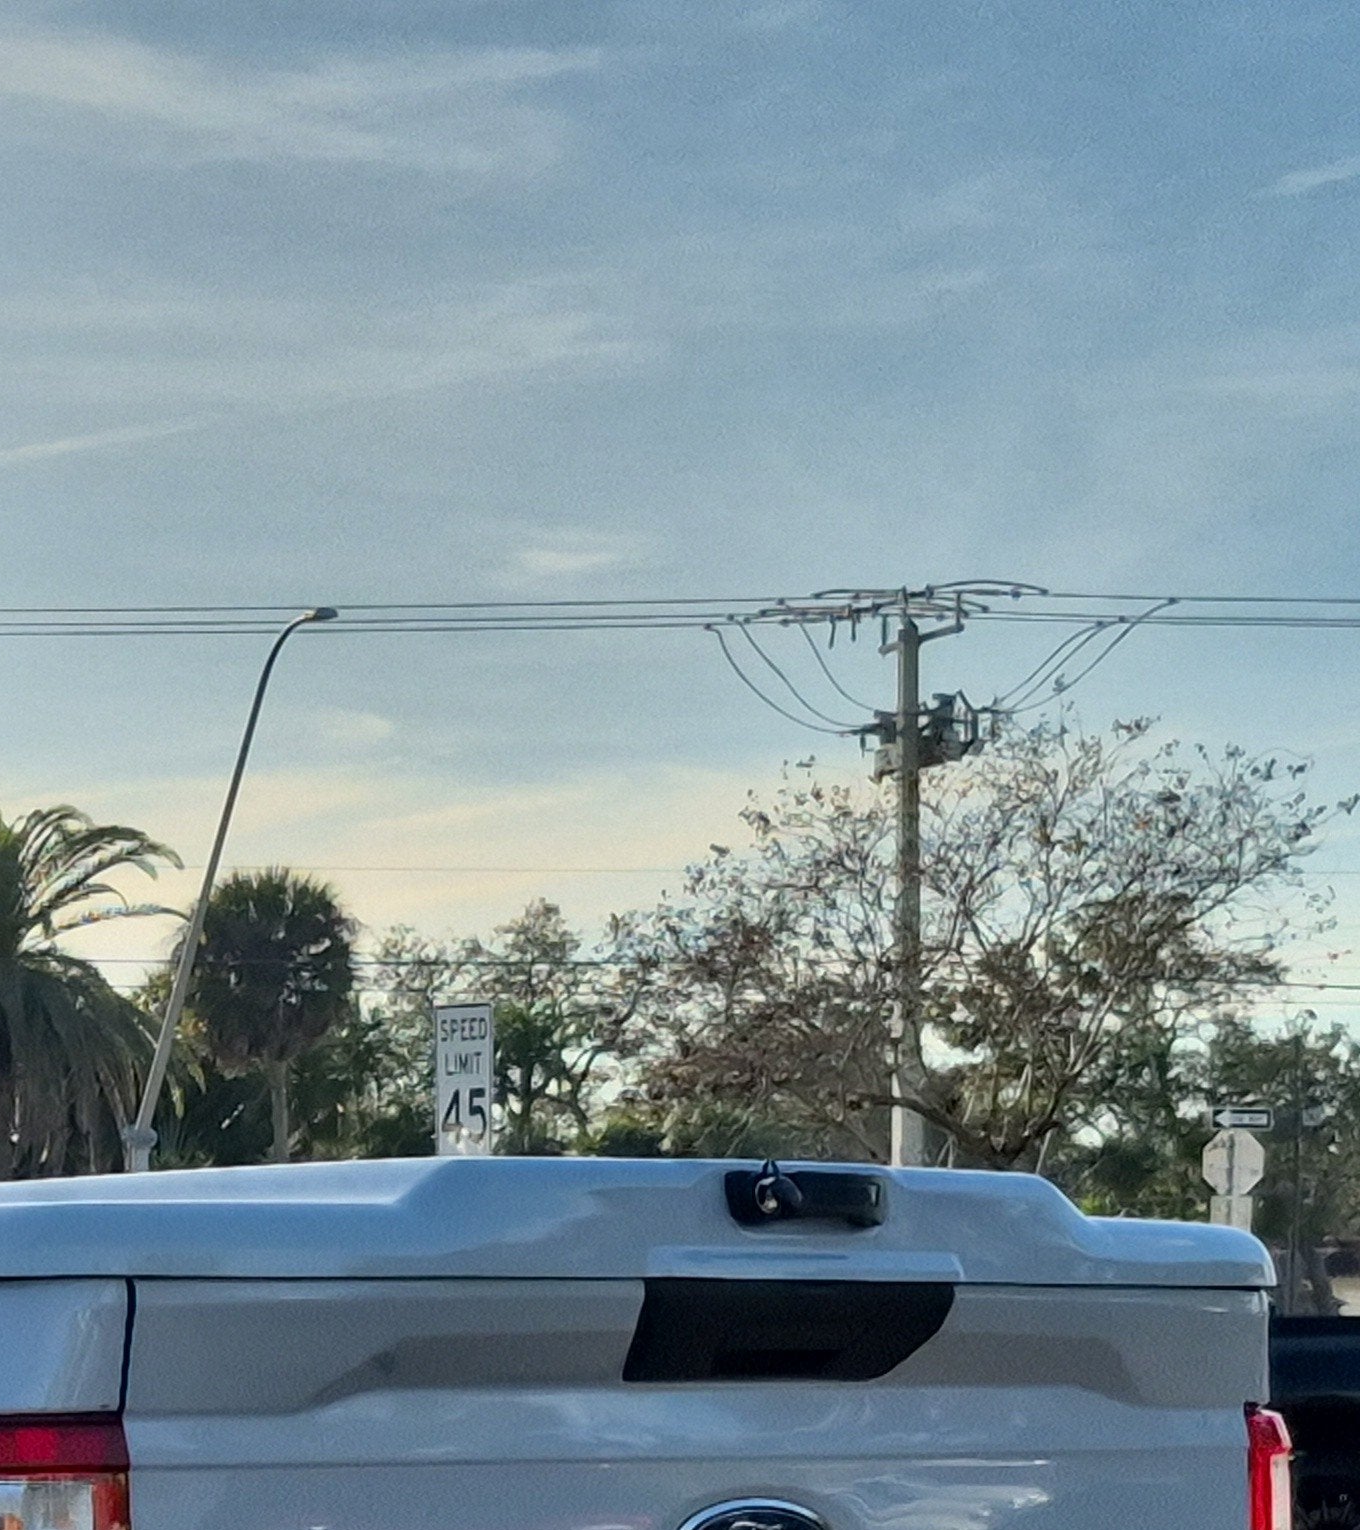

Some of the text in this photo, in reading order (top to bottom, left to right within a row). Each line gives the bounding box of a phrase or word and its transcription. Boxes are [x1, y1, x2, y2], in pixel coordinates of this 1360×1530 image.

[440, 1018, 487, 1041] SPEED
[445, 1052, 482, 1076] LIMIT
[441, 1087, 488, 1143] 45
